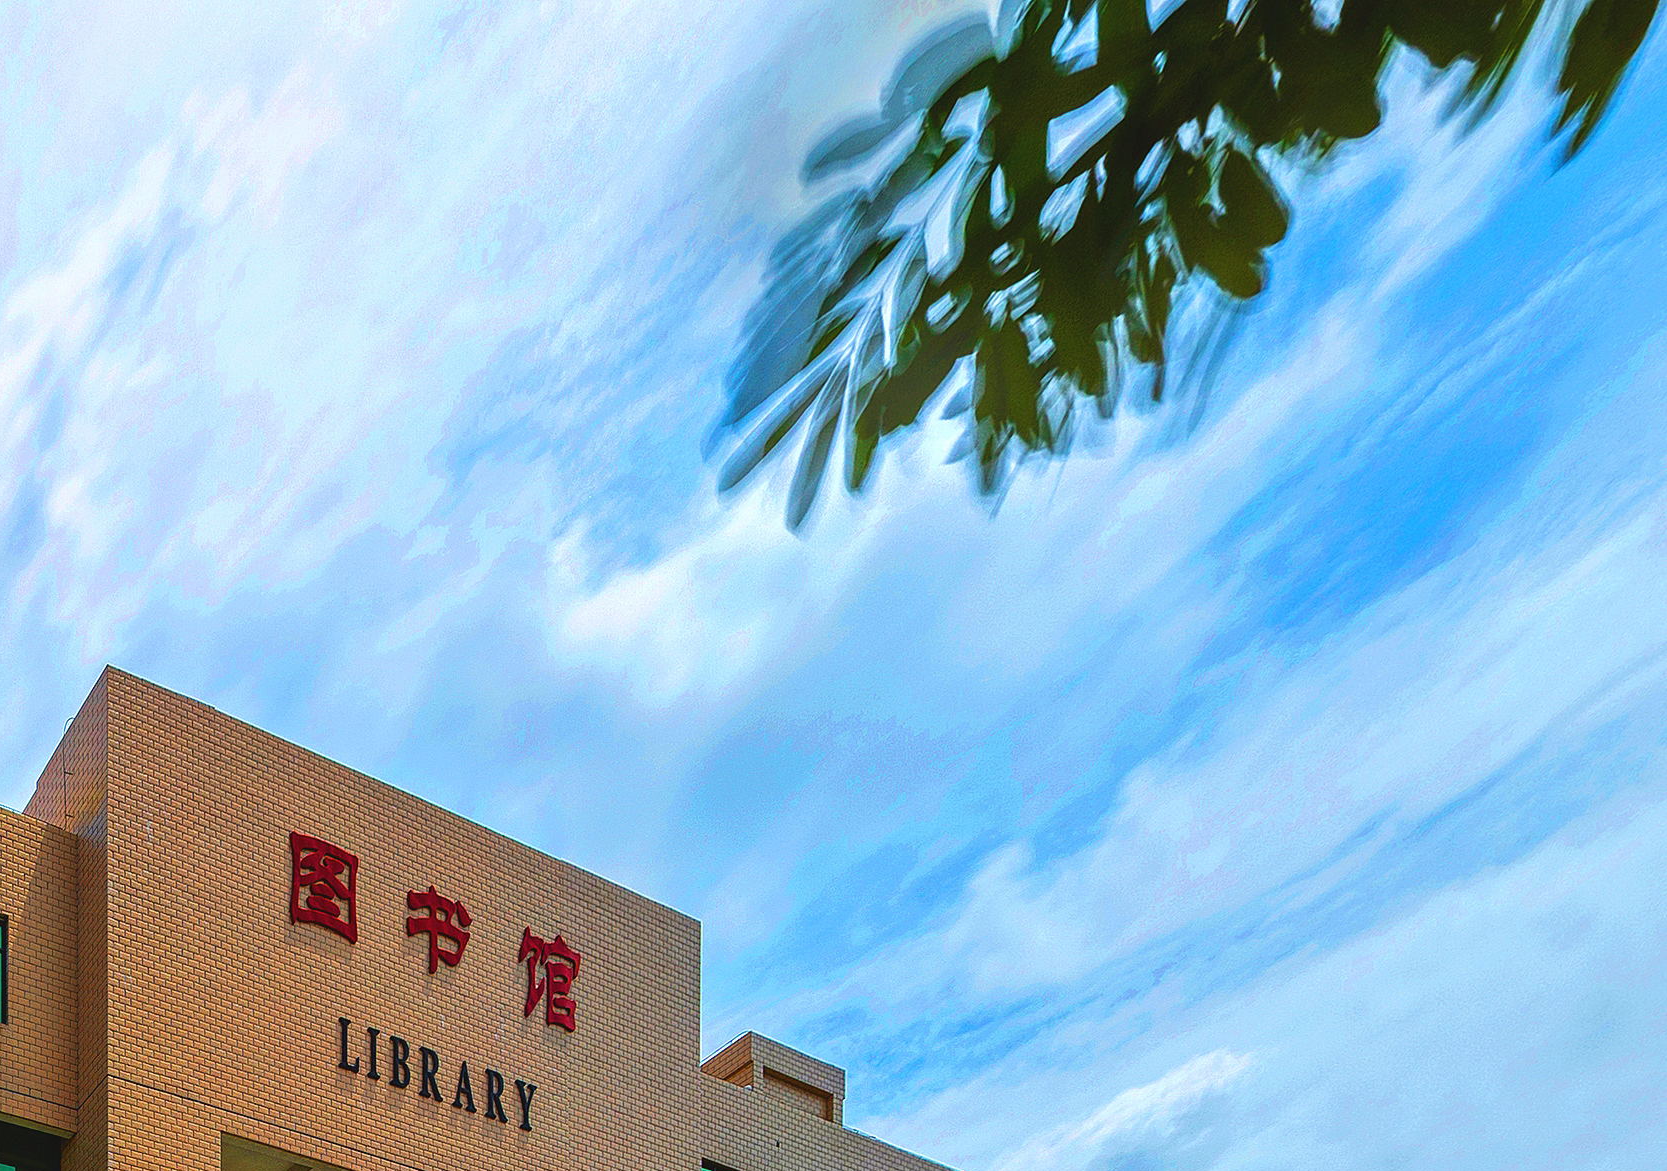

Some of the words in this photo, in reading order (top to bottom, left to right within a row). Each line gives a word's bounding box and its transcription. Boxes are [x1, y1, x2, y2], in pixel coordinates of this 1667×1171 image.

[289, 830, 581, 1032] 图书馆
[338, 1016, 537, 1132] LIBRARY
